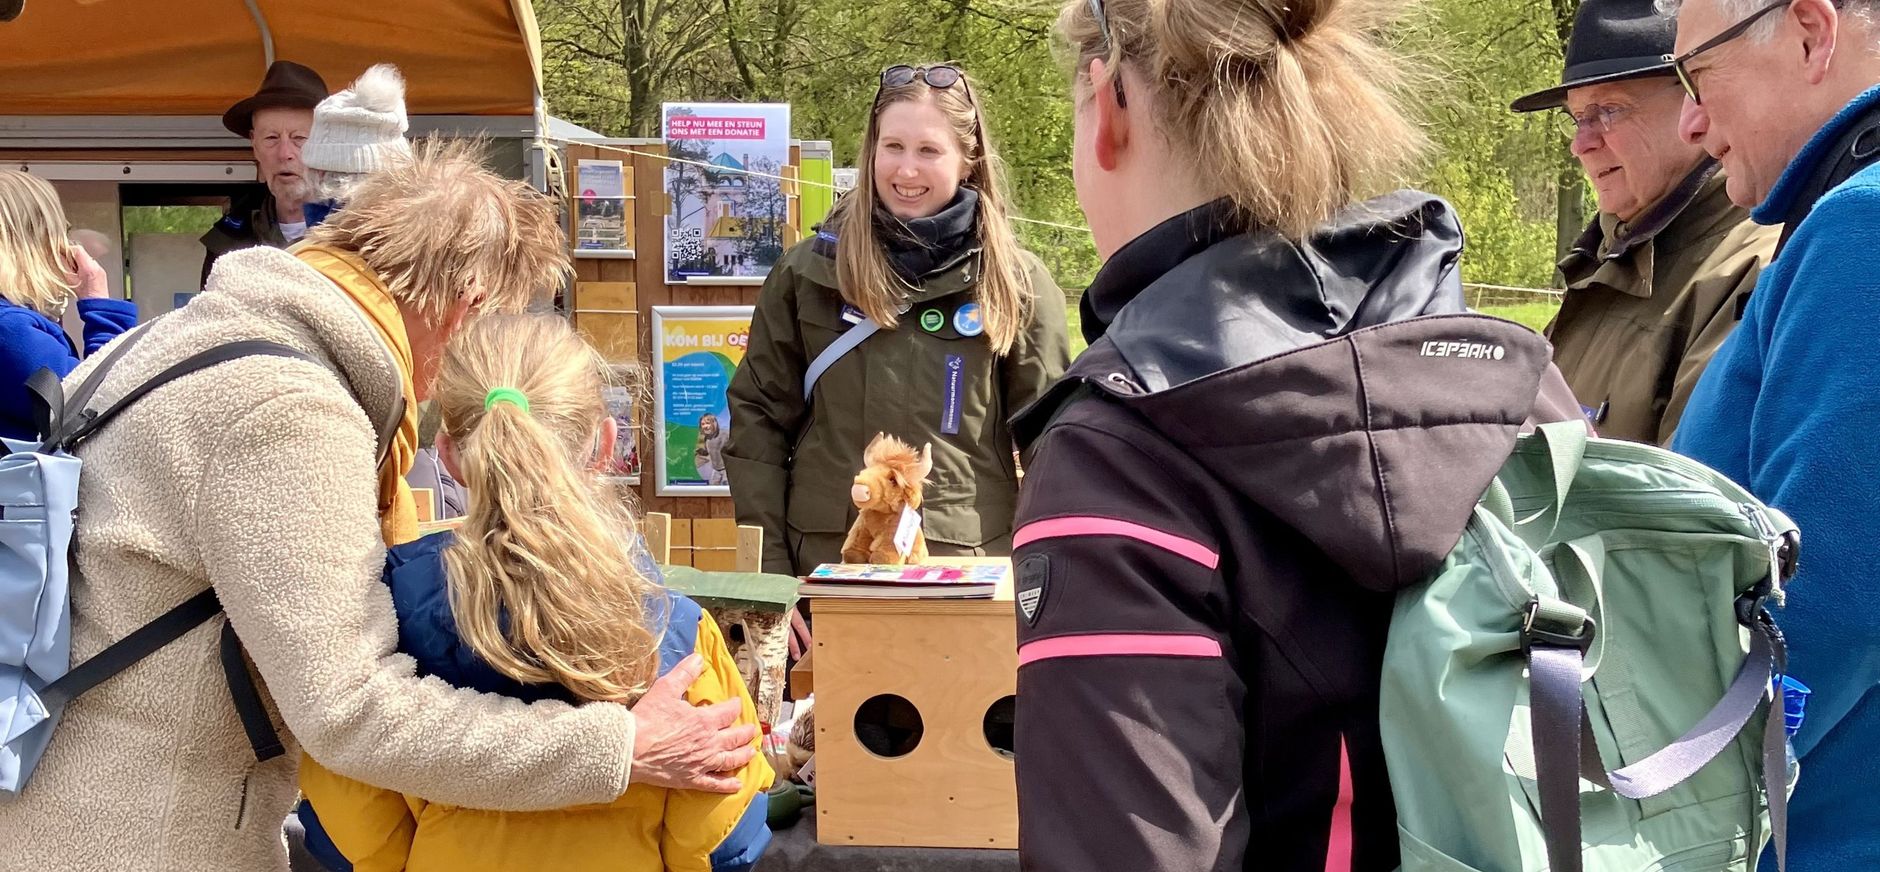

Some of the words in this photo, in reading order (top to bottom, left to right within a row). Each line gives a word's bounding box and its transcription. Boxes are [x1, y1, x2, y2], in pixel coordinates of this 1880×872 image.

[665, 334, 698, 347] KOM
[702, 334, 723, 347] BIJ
[1420, 340, 1494, 360] ICEPEAK
